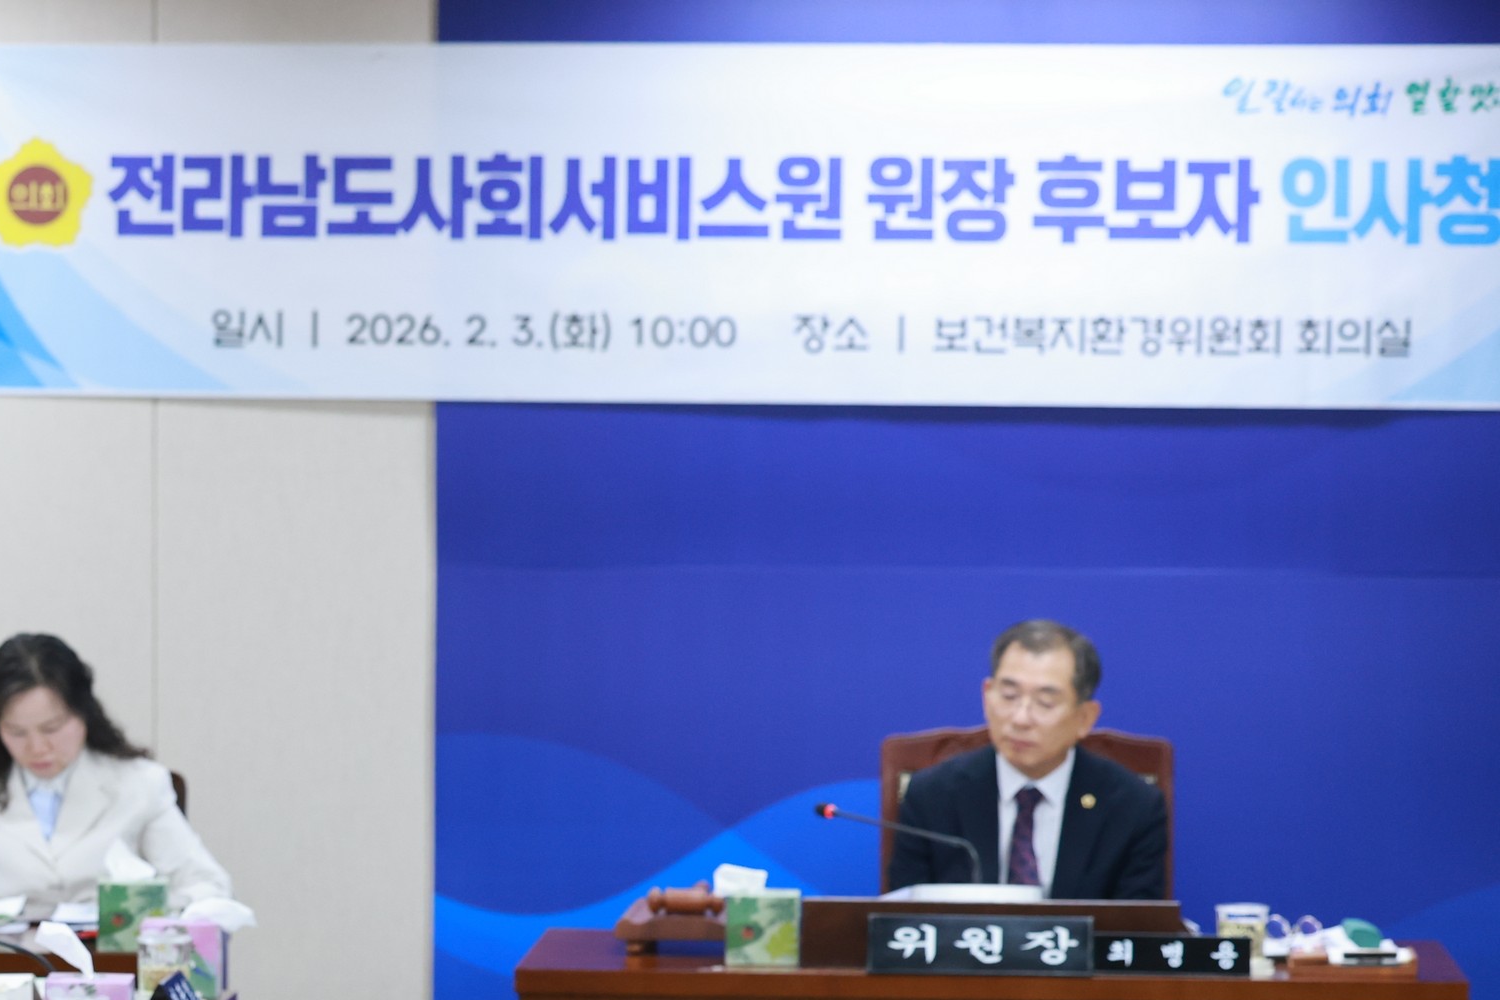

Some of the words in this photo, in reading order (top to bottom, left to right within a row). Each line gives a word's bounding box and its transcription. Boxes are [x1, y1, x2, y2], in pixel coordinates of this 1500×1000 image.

[10, 180, 65, 212] 의회
[107, 152, 842, 242] 전라남도사회서비스원
[866, 156, 1016, 243] 원장
[1032, 154, 1261, 244] 후보자
[211, 310, 284, 349] 일시
[346, 313, 451, 348] 2026.
[465, 313, 497, 348] 2.
[630, 315, 738, 349] 10:00
[794, 314, 869, 354] 장소
[934, 316, 1283, 358] 보건복지환경위원회
[1296, 317, 1413, 359] 회의실
[886, 923, 1080, 966] 위원장
